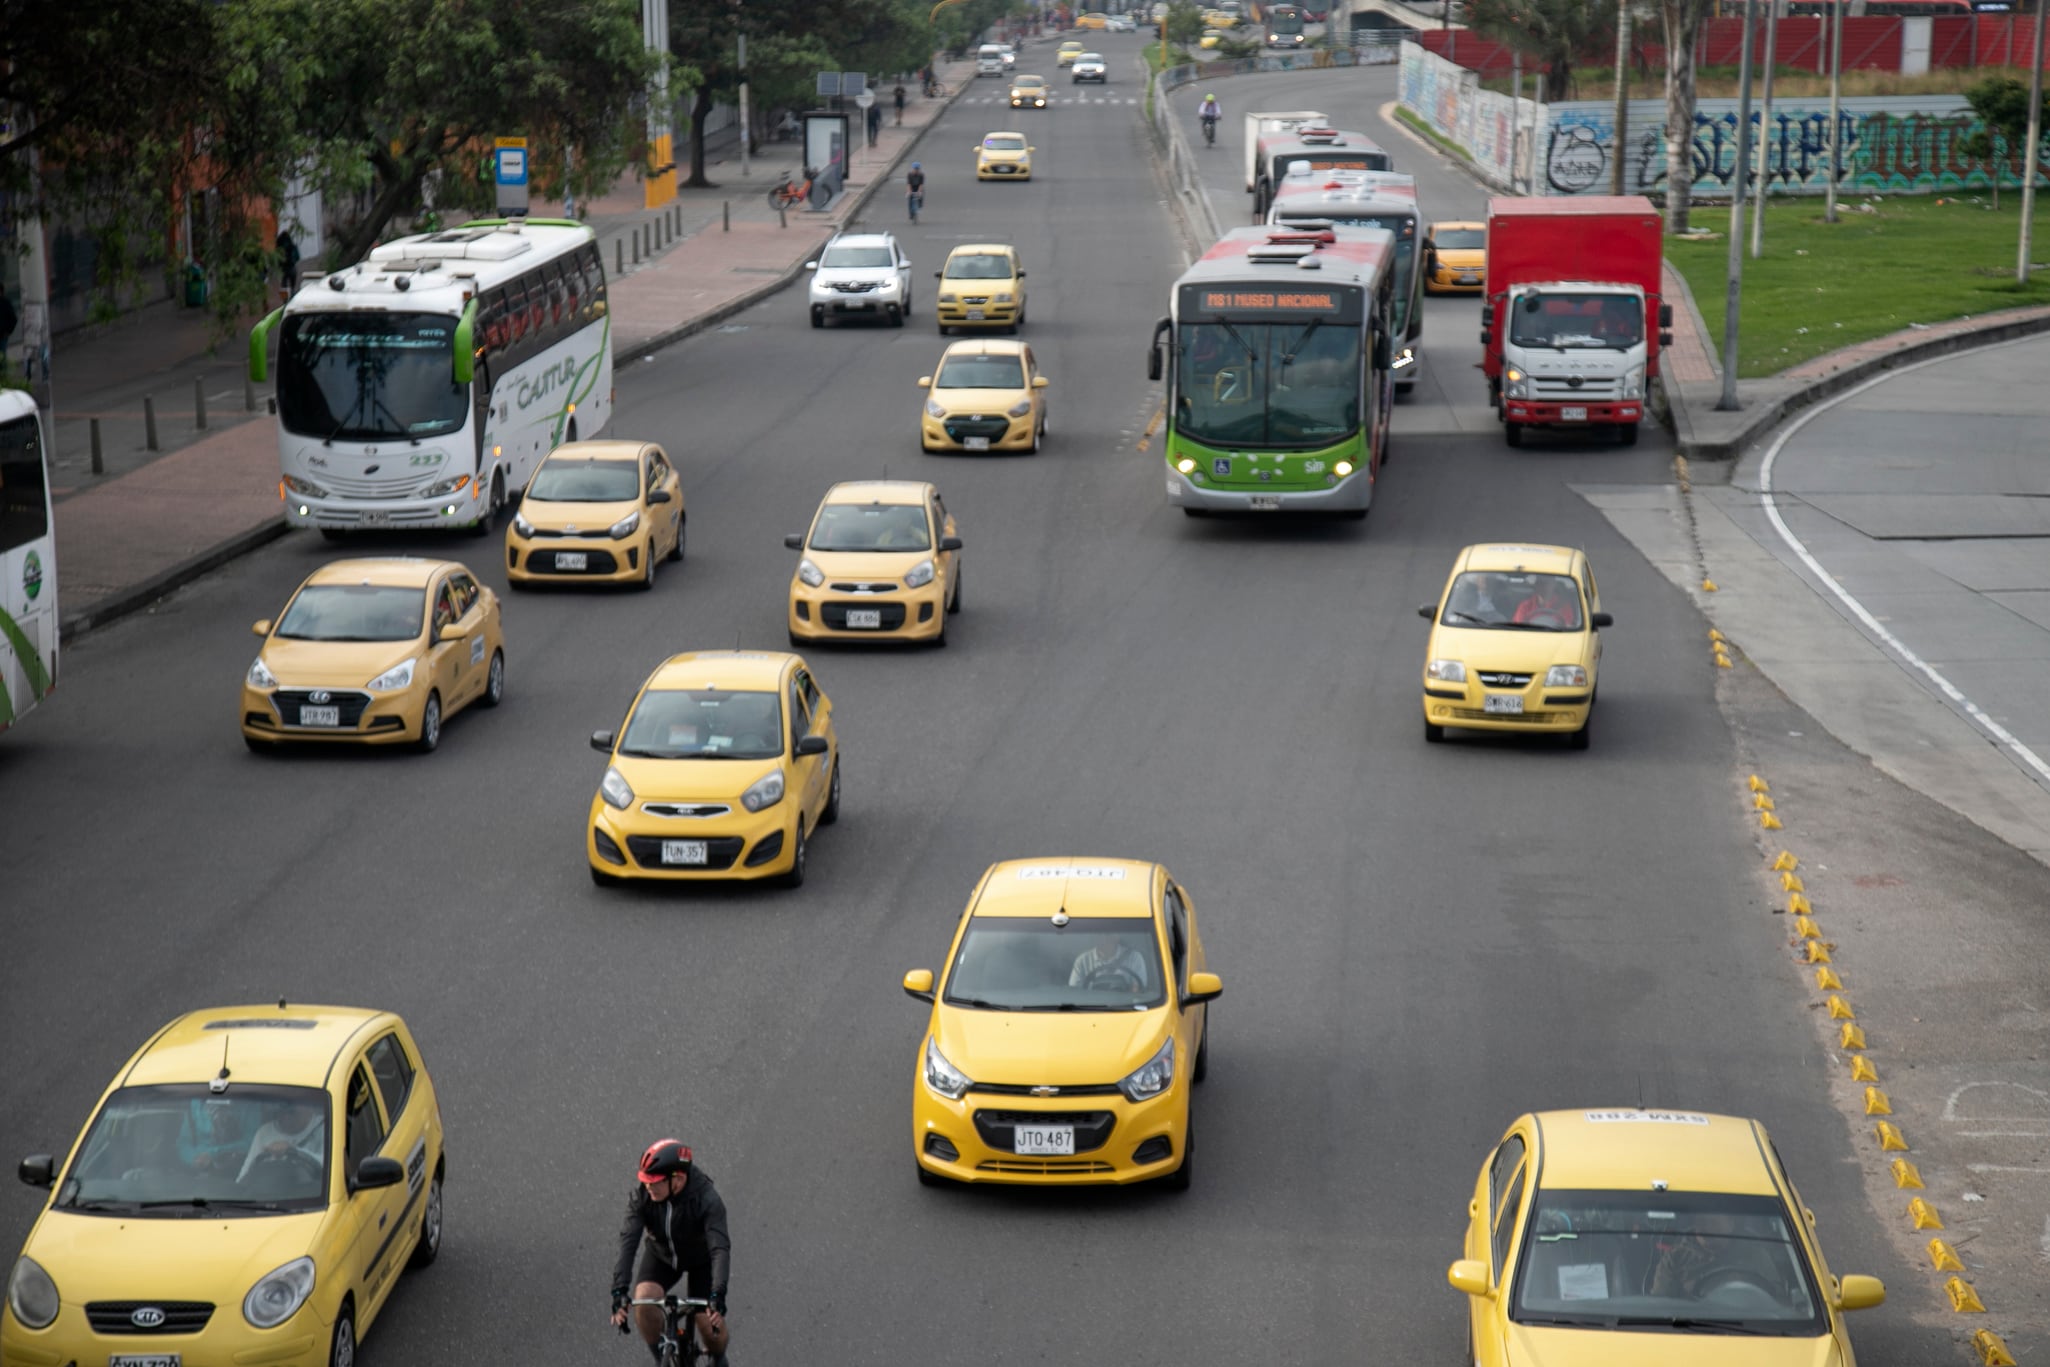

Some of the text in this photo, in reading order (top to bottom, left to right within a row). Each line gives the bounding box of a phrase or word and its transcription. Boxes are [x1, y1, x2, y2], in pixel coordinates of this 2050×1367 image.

[1234, 293, 1274, 307] MUSEO
[1277, 294, 1334, 308] NACIONAL
[1046, 1131, 1072, 1148] 487
[136, 1310, 160, 1324] KIA
